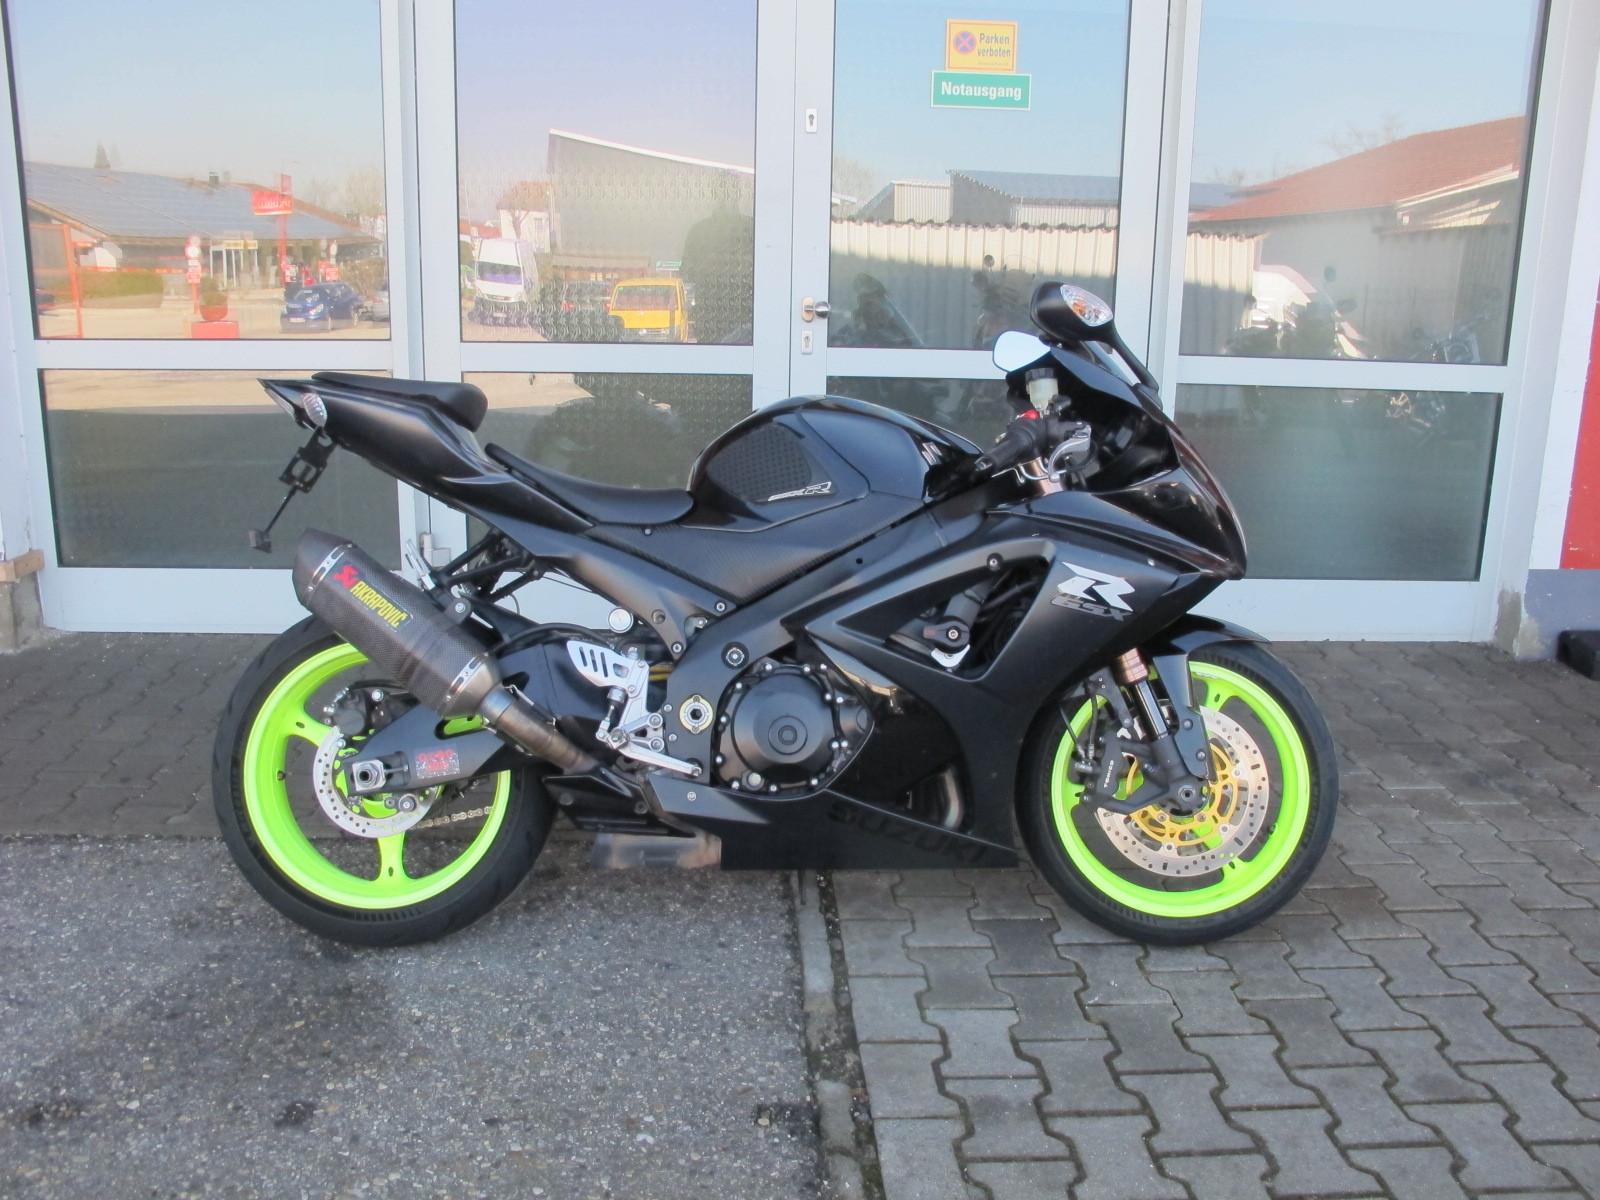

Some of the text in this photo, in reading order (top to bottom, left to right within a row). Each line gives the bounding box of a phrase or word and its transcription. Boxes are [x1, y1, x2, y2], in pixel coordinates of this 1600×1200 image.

[979, 32, 1010, 45] Parken
[977, 46, 1011, 57] verboten
[941, 81, 1022, 100] Notausgang
